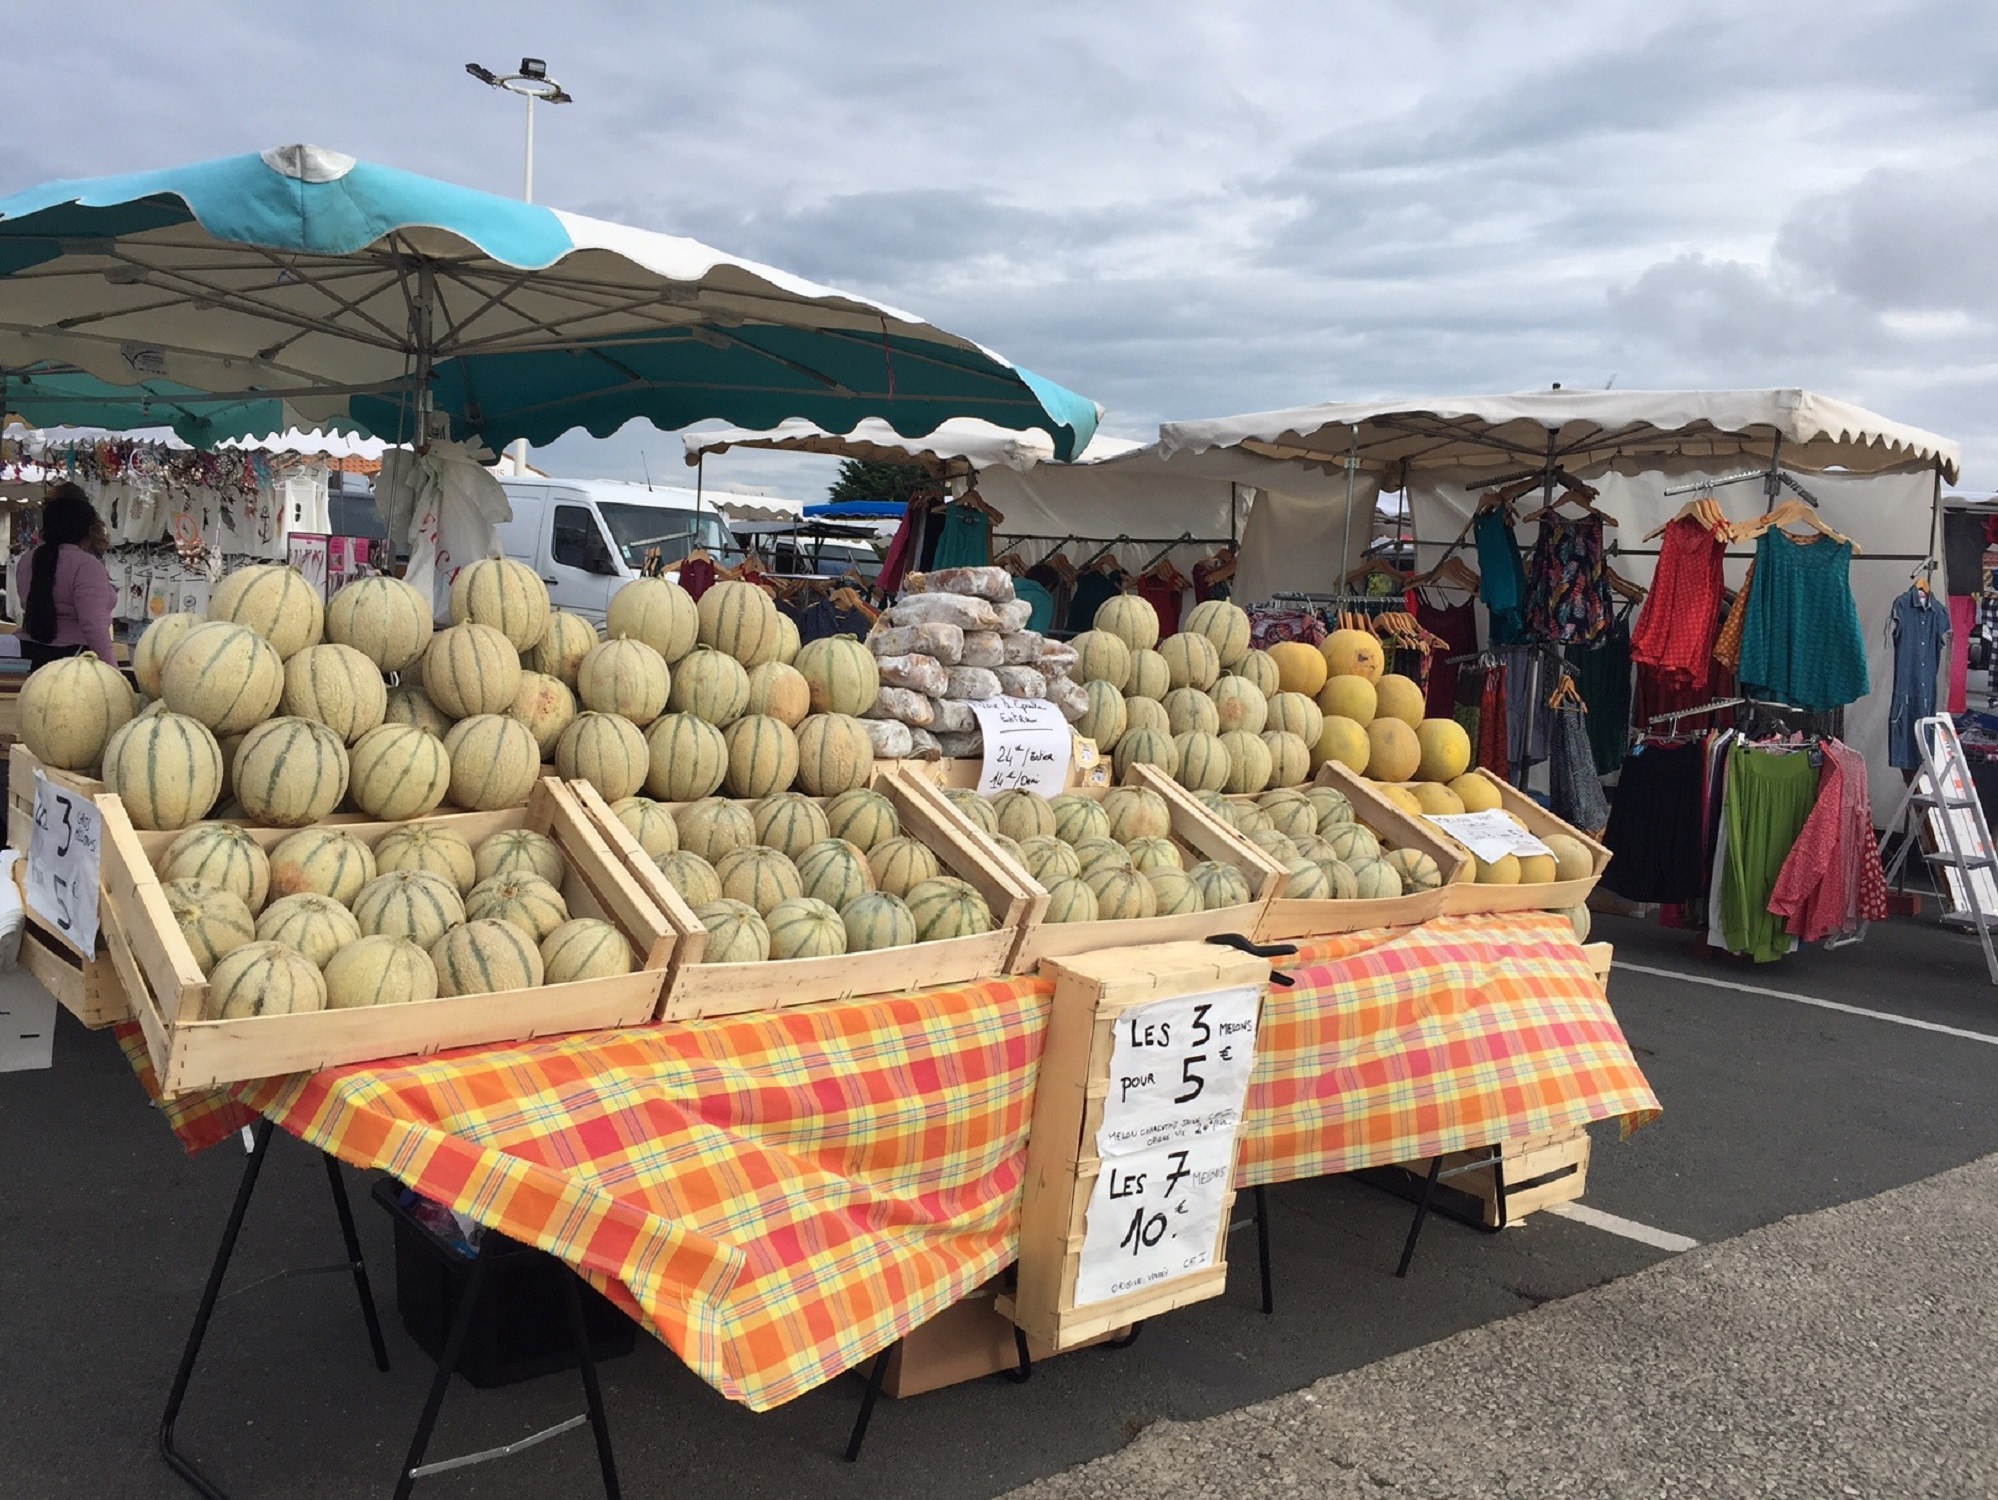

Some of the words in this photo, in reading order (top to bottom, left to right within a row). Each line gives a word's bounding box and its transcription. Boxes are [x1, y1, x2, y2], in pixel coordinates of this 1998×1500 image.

[56, 794, 72, 857] 3
[53, 874, 72, 930] 5
[1131, 1018, 1171, 1047] LES
[1191, 1004, 1213, 1047] 3
[1219, 1020, 1252, 1036] MELONS
[1120, 1073, 1155, 1102] POUR
[1174, 1055, 1207, 1104] 5
[1109, 1168, 1147, 1200] LES
[1163, 1150, 1191, 1198] 7
